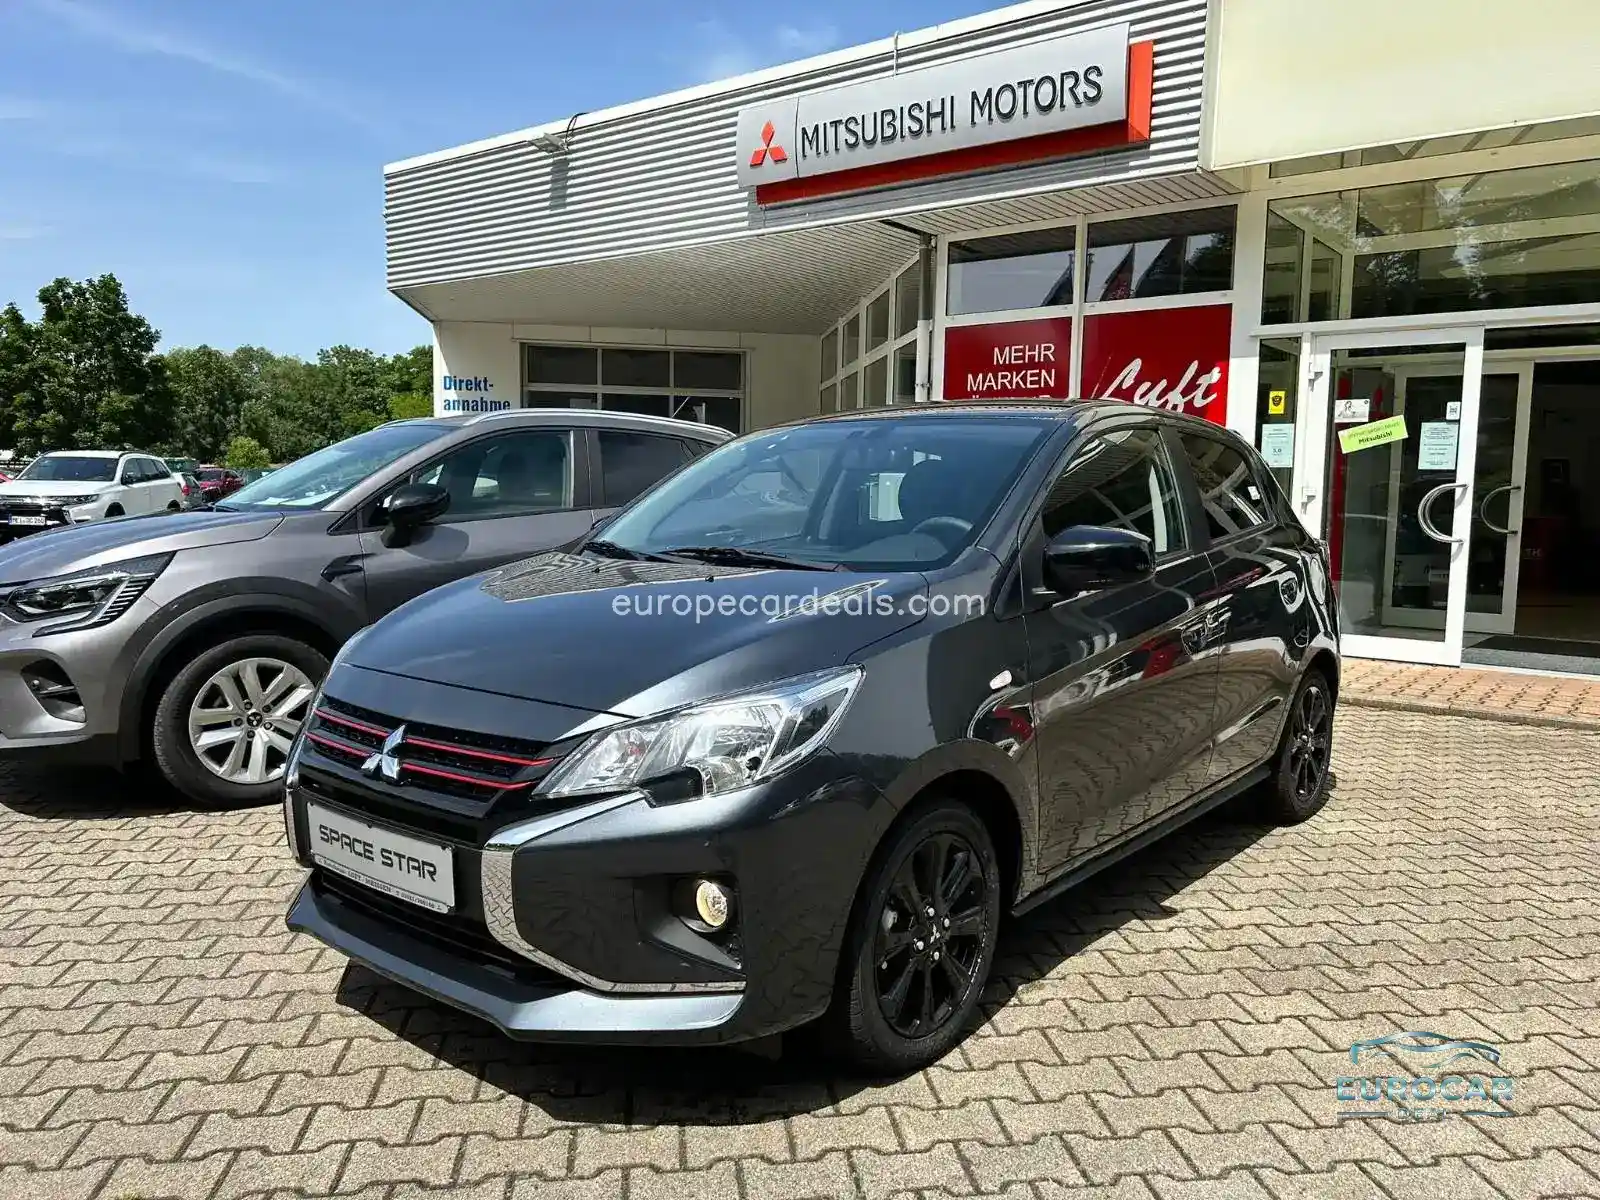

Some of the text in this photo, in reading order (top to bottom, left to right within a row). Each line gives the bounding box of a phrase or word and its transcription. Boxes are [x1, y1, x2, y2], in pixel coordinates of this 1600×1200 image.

[801, 65, 1104, 159] MITSUBISHI MOTORS
[993, 343, 1056, 366] MEHR
[443, 375, 494, 392] Direkt-
[966, 368, 1056, 392] MARKEN
[443, 397, 511, 412] annahme
[319, 823, 375, 862] SPACE
[380, 847, 437, 883] STAR
